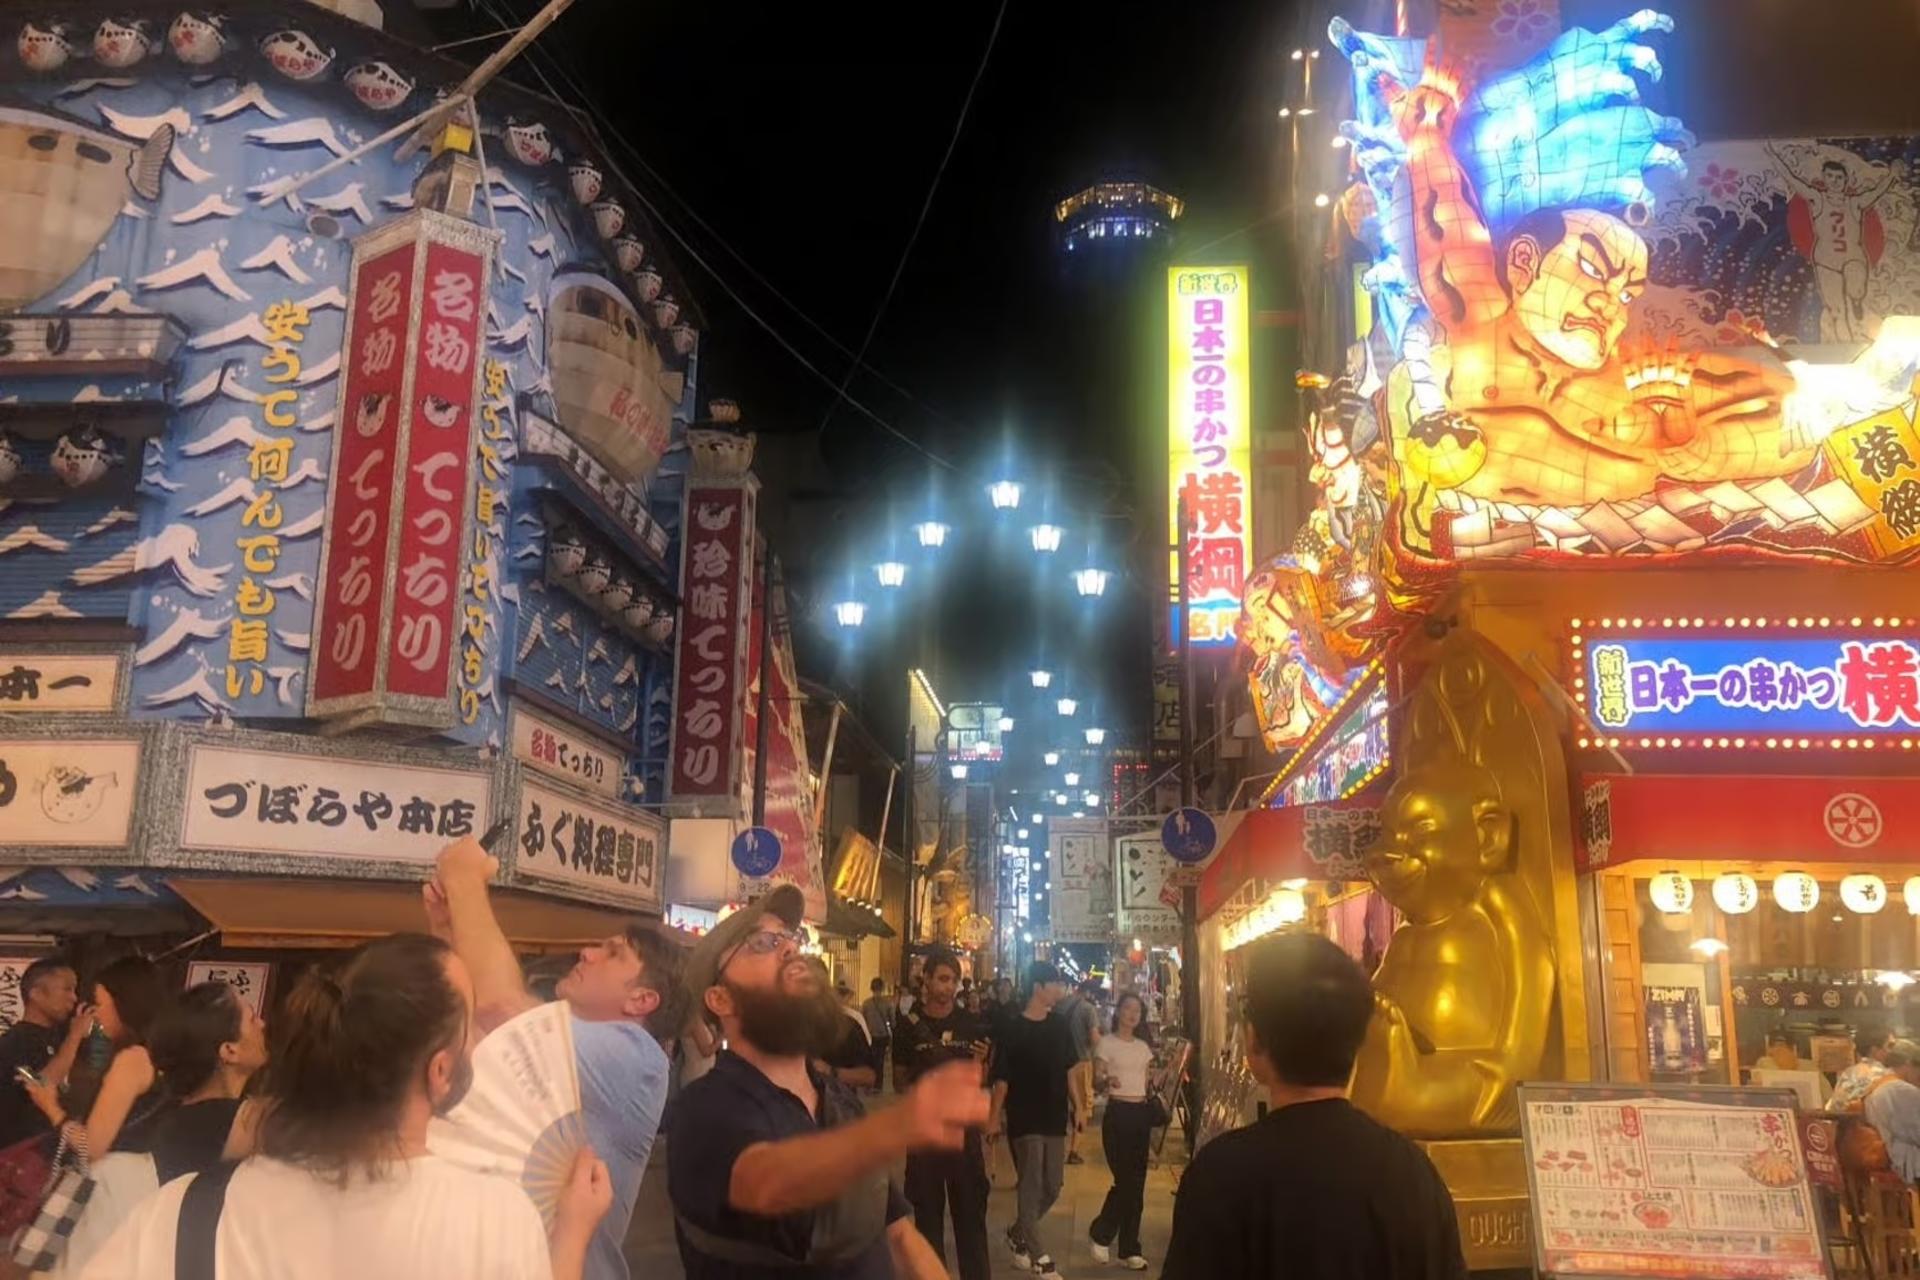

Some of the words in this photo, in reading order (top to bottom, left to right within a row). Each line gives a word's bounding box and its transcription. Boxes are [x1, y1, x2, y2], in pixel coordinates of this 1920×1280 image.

[1192, 299, 1228, 468] 日本一の串かつ
[225, 299, 311, 699] 安うて何んでも旨い
[1597, 648, 1627, 724] 新世界
[1630, 662, 1836, 708] 日本一の串かつ
[1840, 645, 1920, 723] 横
[203, 779, 476, 839] づぼらや本店
[521, 800, 654, 888] ふぐ料理専門
